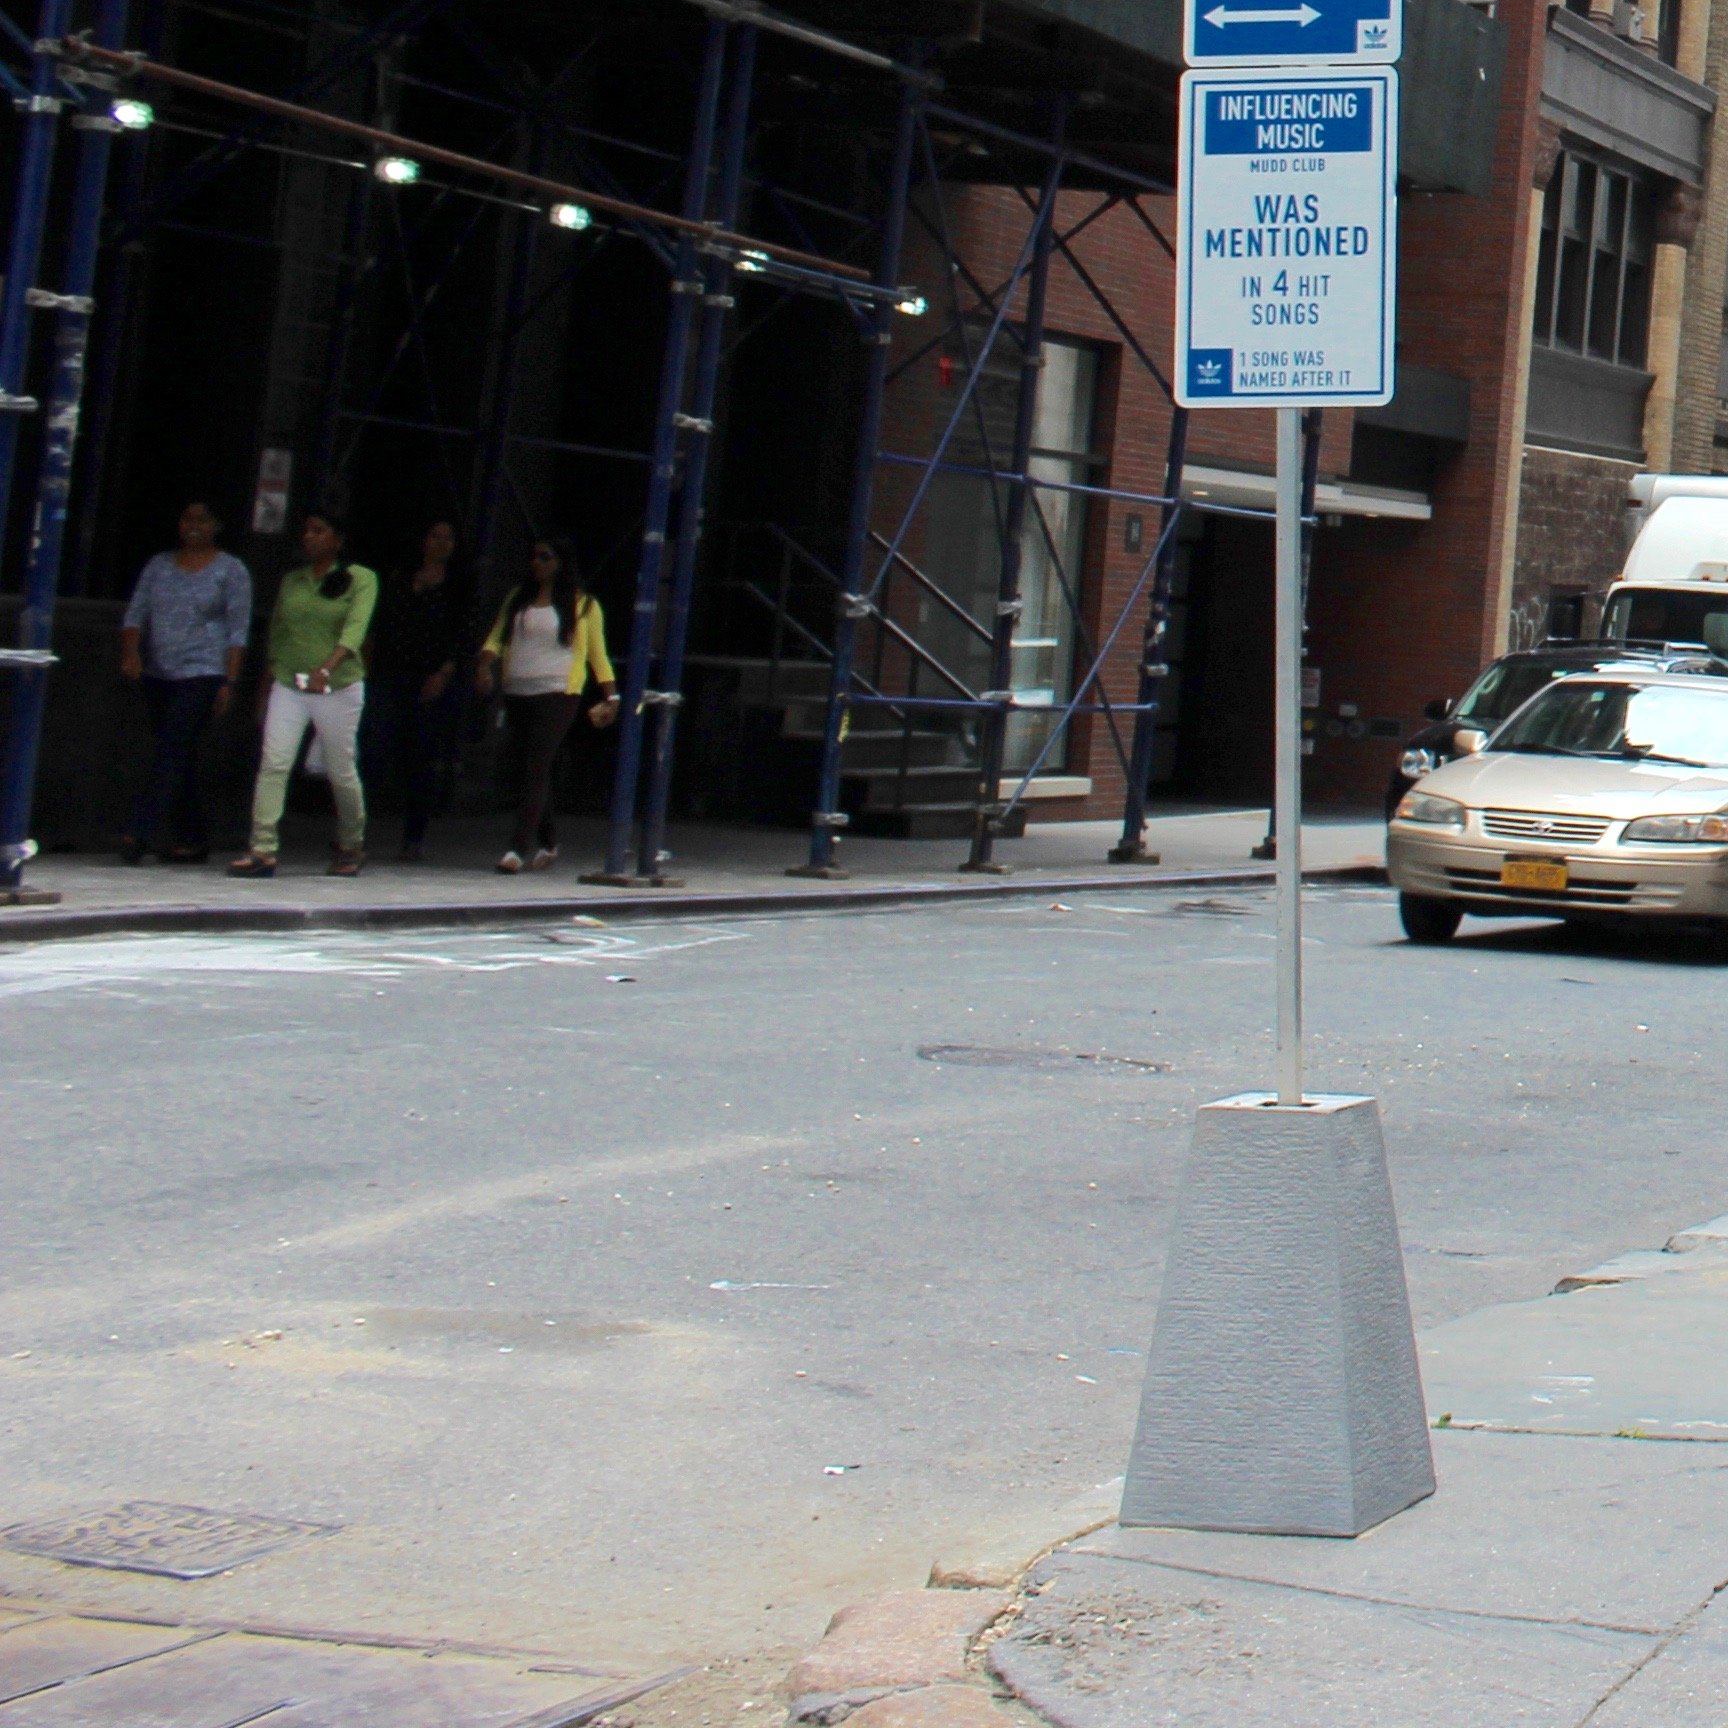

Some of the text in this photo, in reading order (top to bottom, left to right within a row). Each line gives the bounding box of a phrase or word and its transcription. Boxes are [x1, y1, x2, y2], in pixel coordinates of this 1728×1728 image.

[1220, 94, 1357, 121] INFLUENCING
[1257, 124, 1325, 149] MUSIC
[1250, 159, 1326, 173] MUDD CLUB
[1255, 195, 1319, 224] WAS
[1206, 227, 1369, 258] MENTIONED
[1242, 270, 1330, 297] IN 4 HIT
[1252, 304, 1319, 325] SONGS
[1240, 351, 1324, 366] 1 SONG WAS
[1240, 371, 1351, 387] NAMED AFTER IT
